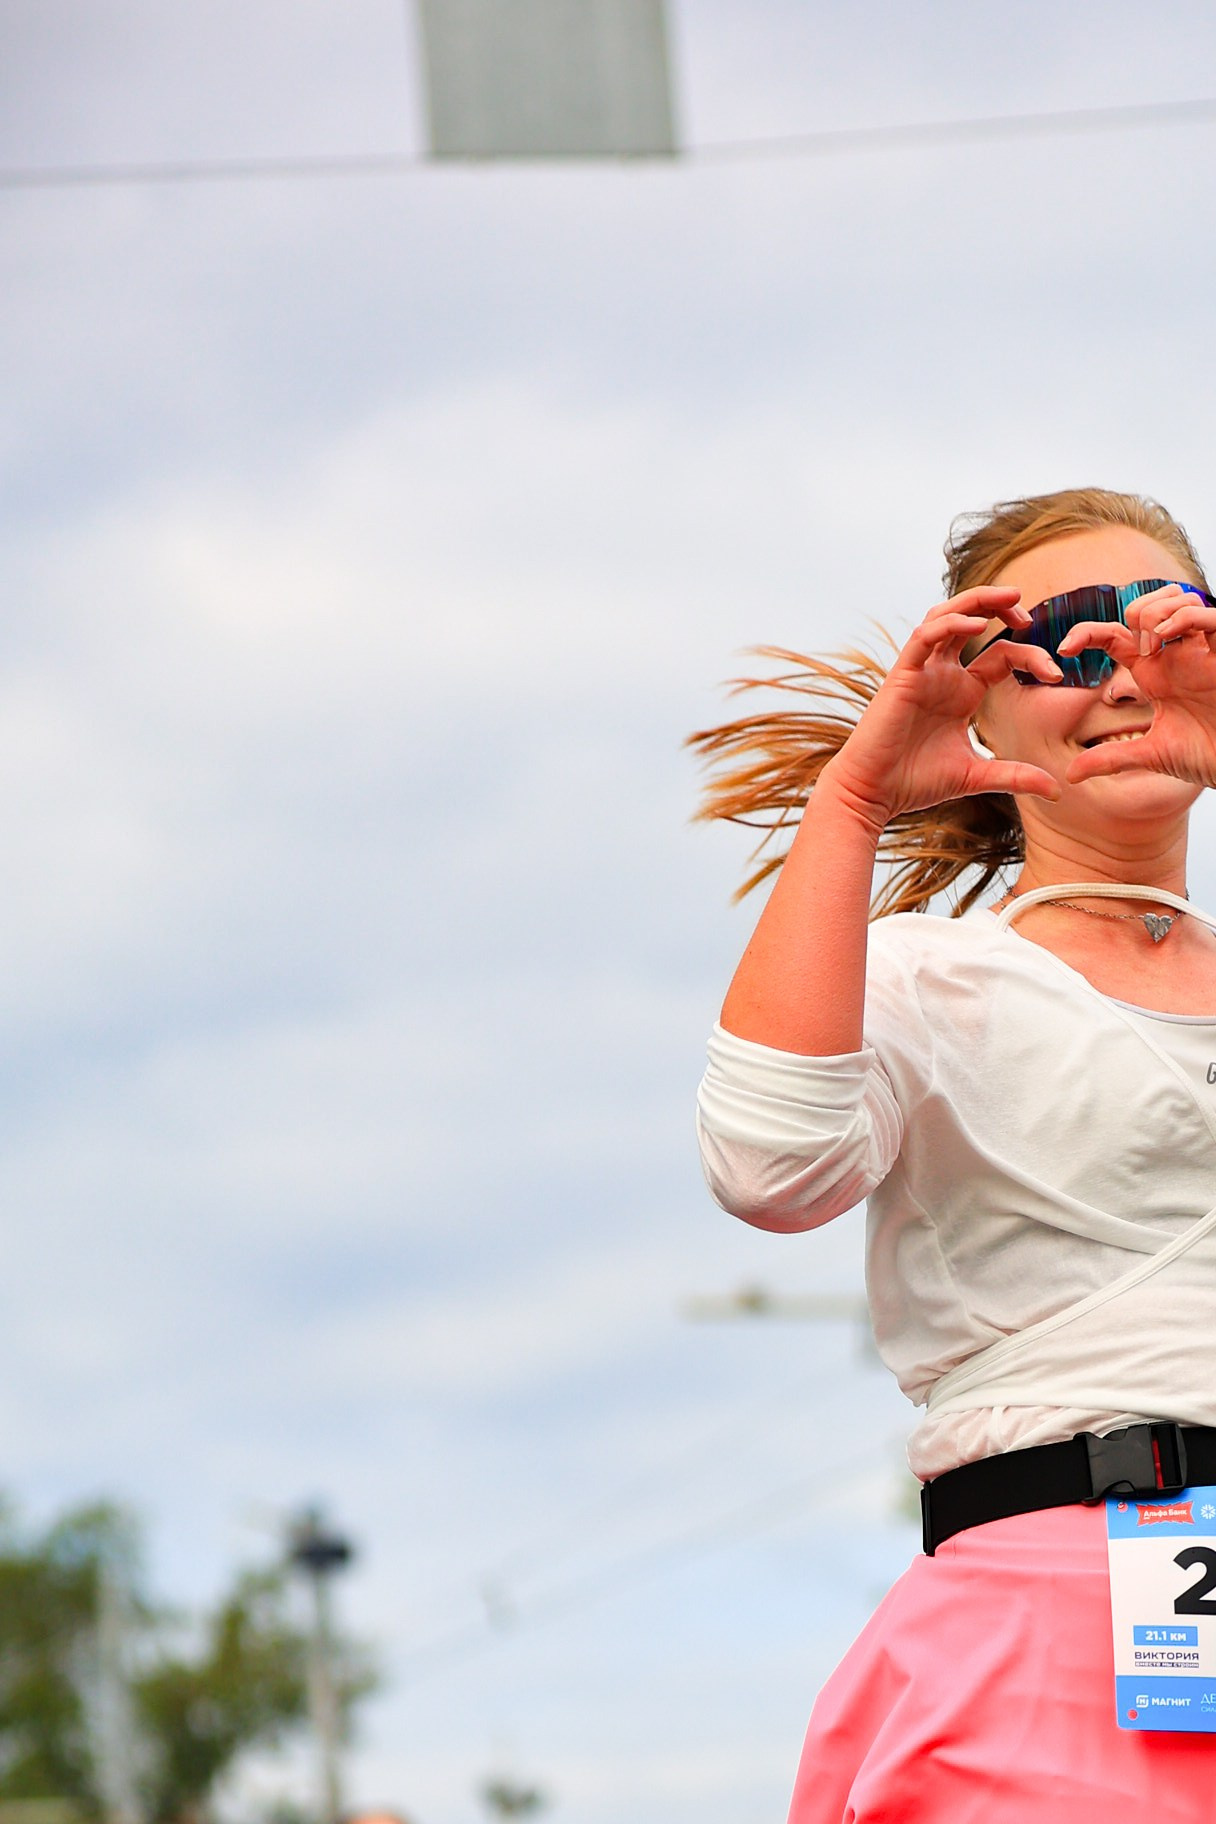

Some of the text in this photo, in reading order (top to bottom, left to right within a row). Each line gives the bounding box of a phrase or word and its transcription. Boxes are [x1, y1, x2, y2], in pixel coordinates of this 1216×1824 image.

[1143, 1508, 1187, 1519] Альфа Банк
[1145, 1630, 1168, 1641] 21.1
[1134, 1651, 1199, 1661] ВИКТОРИЯ
[1151, 1697, 1191, 1706] МАГНИТ
